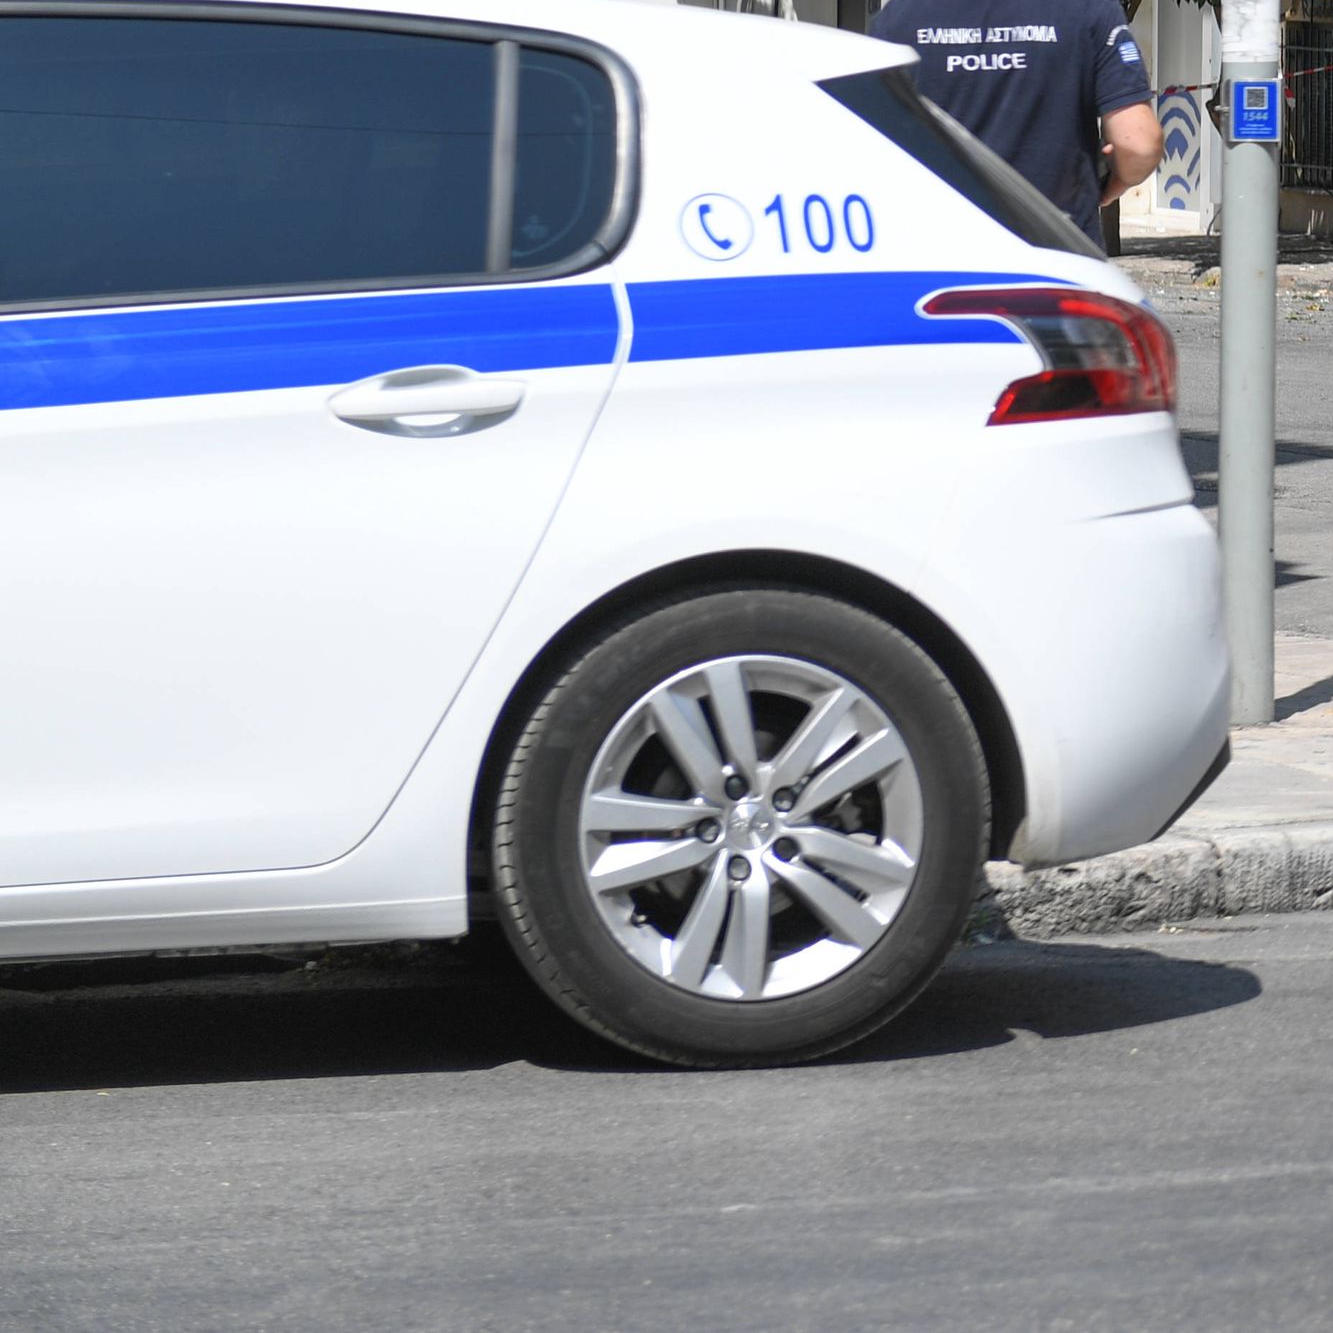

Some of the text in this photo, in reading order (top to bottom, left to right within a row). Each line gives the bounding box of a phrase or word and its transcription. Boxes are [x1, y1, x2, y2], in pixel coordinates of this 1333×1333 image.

[916, 25, 1057, 44] ΕΛΛΗΝΙΚΗ ΑΣΤΥΝΟΜΙΑ
[946, 53, 1027, 72] POLICE
[764, 193, 876, 254] 100
